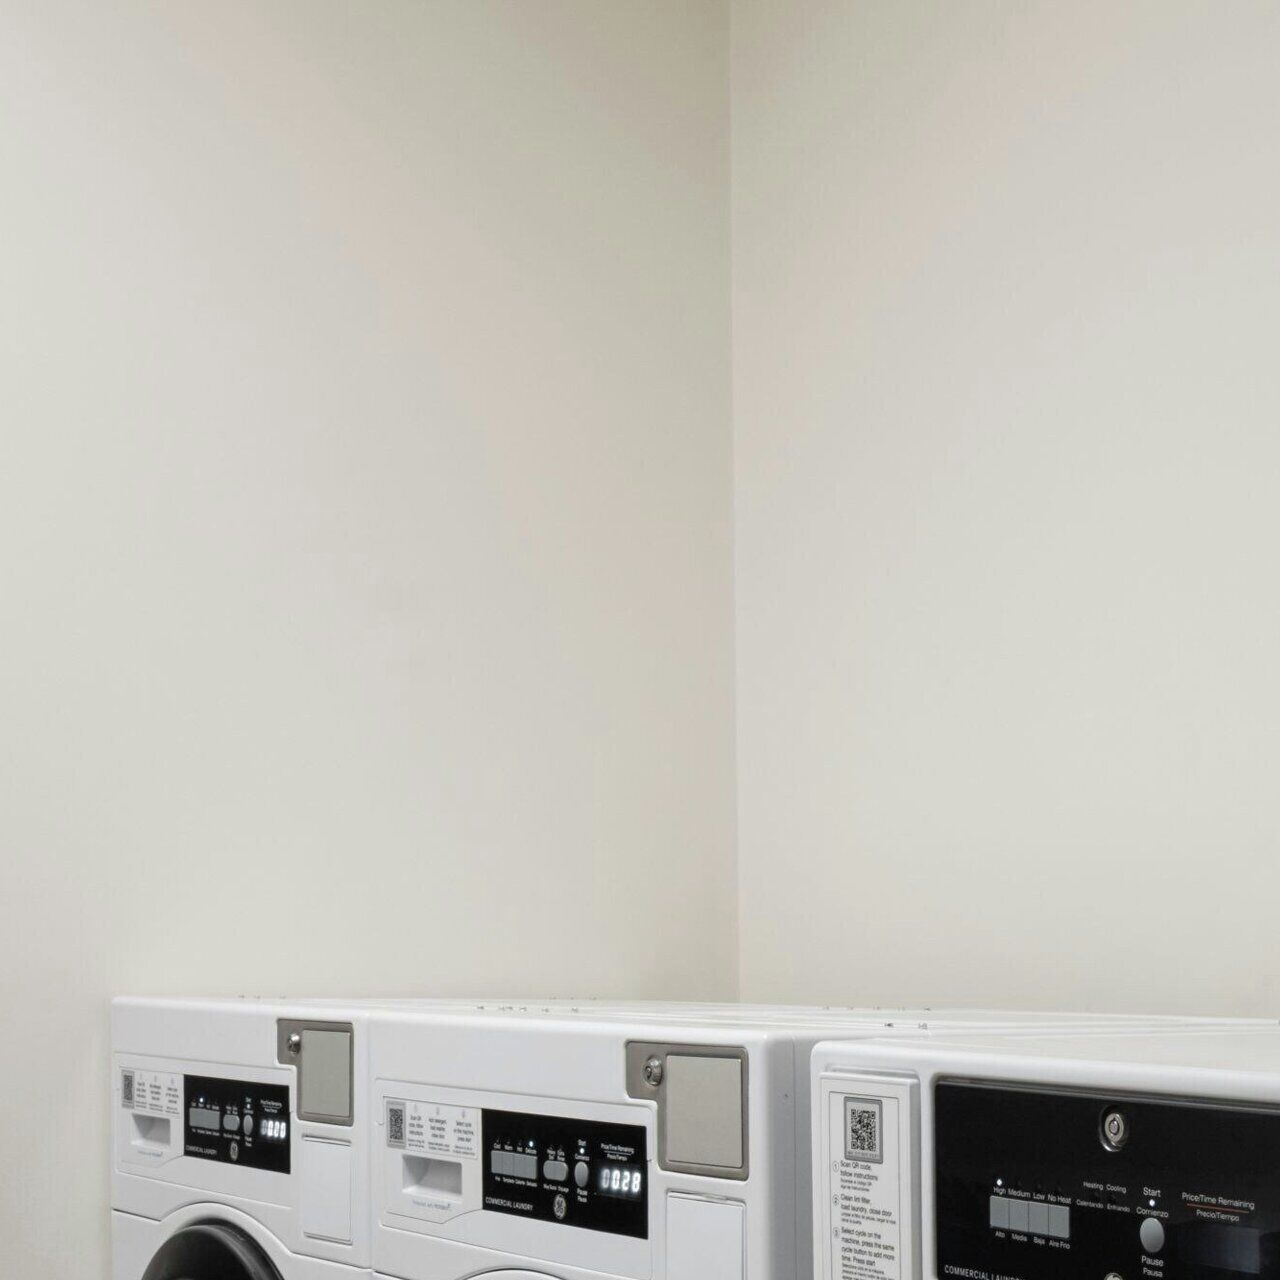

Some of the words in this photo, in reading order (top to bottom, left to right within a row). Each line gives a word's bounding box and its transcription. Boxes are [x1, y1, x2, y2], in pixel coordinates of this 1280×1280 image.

[854, 1173, 878, 1181] instructions
[1083, 1181, 1104, 1190] Heating
[1106, 1184, 1126, 1194] Cooling
[1143, 1187, 1161, 1198] Start
[993, 1186, 1006, 1196] High
[1008, 1188, 1030, 1198] Medium
[1033, 1192, 1045, 1200] Low
[1048, 1194, 1056, 1202] No
[1058, 1196, 1072, 1204] Heat
[486, 1196, 512, 1208] COMMERCIAL
[513, 1202, 534, 1210] LAUNDRY
[1076, 1199, 1104, 1210] Calentando
[1107, 1203, 1130, 1213] Enfriando
[1218, 1197, 1255, 1210] Remaining
[1136, 1207, 1168, 1218] Comienzo
[1196, 1209, 1240, 1222] Precio/Tiempo
[855, 1230, 866, 1238] cycle
[1012, 1233, 1028, 1242] Media
[1034, 1236, 1046, 1246] Baja
[1049, 1239, 1060, 1248] Aire
[853, 1256, 865, 1264] Press
[1142, 1256, 1164, 1267] Pause
[1143, 1268, 1163, 1278] Pausa
